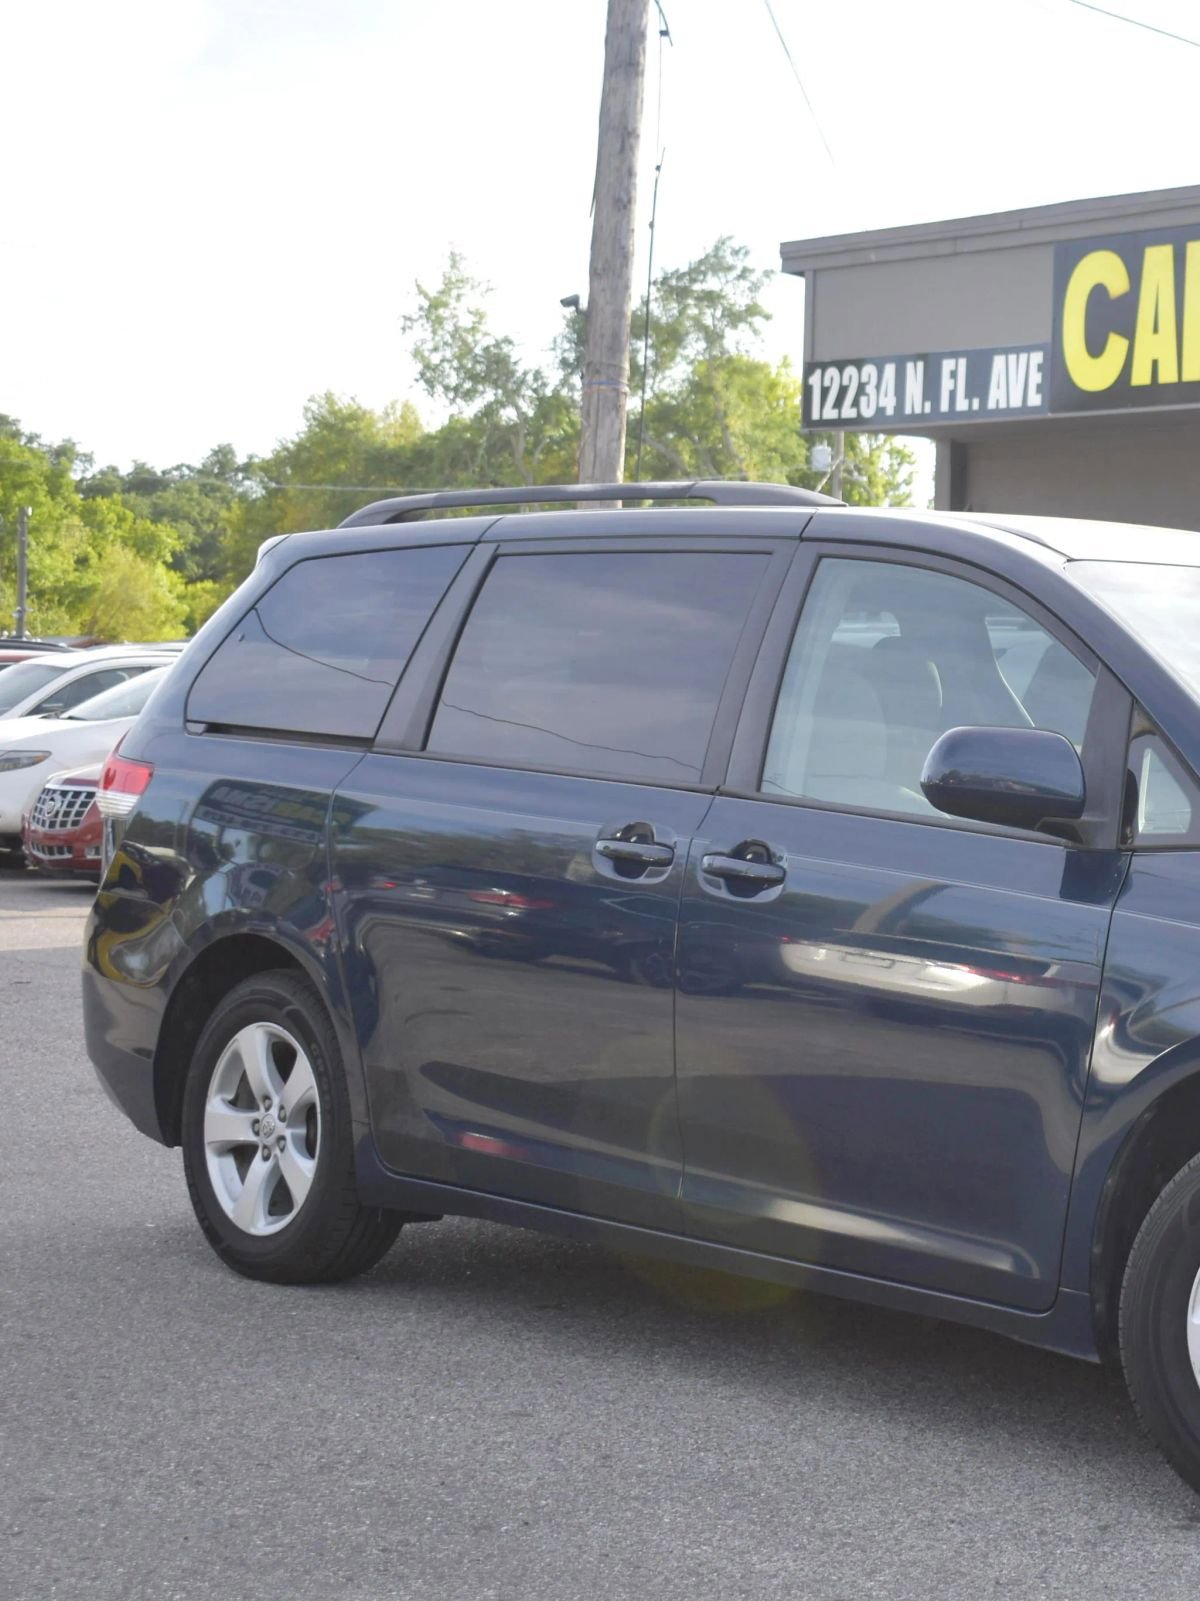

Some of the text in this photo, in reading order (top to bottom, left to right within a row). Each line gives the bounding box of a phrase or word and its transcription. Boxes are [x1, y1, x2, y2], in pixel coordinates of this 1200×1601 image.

[807, 351, 1043, 420] 12234 N. FL. AVE
